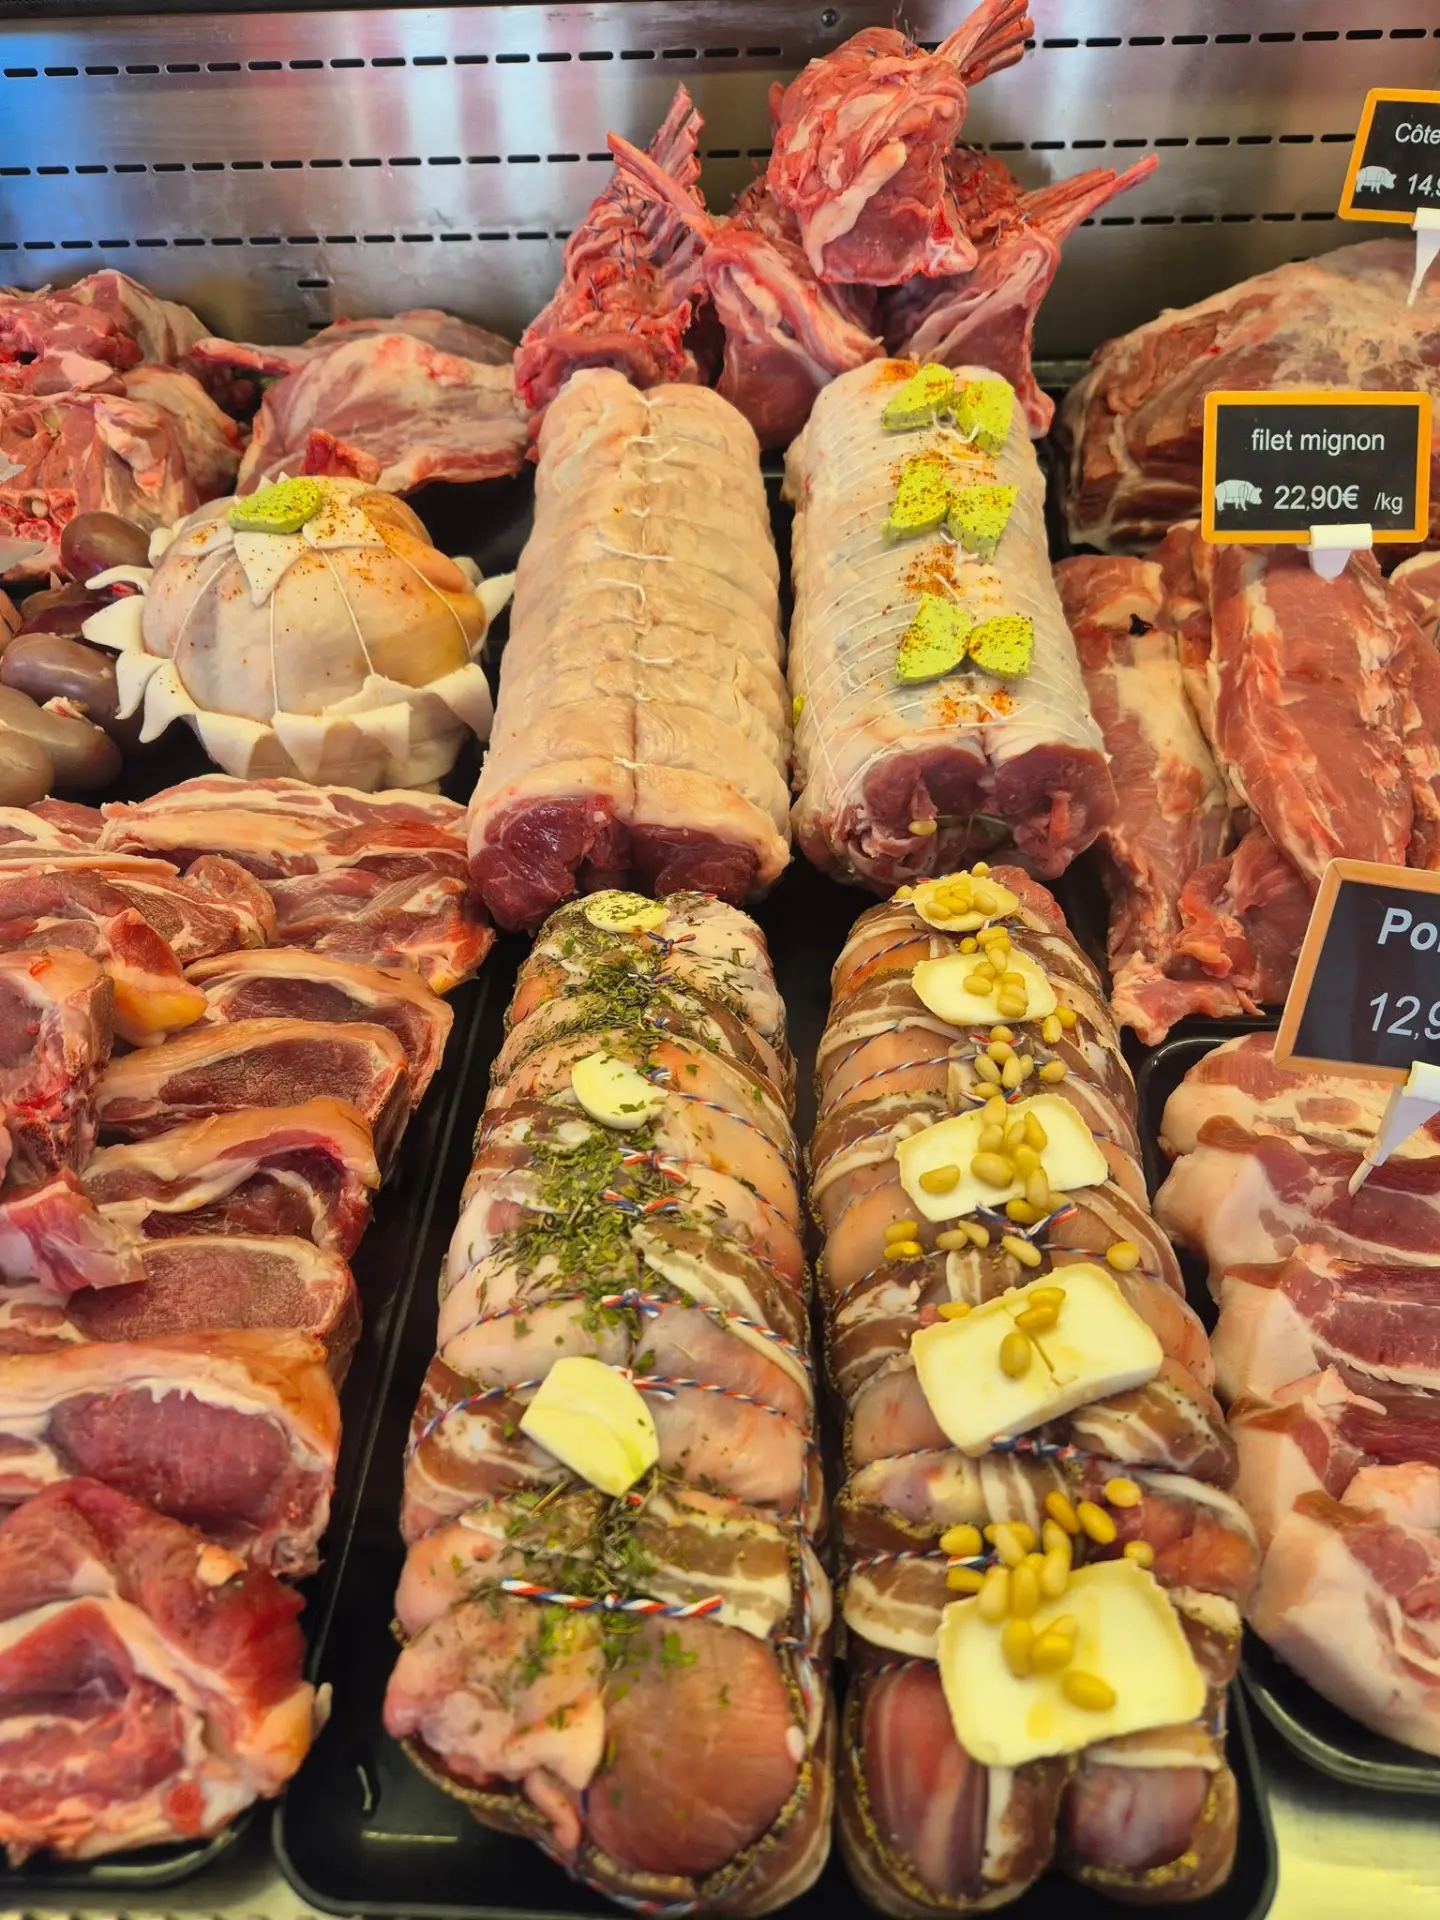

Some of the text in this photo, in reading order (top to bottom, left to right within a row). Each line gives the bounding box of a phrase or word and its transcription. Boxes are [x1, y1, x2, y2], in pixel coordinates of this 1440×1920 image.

[1395, 122, 1440, 145] Côte
[1251, 428, 1385, 457] filet mignon
[1273, 484, 1403, 515] 22,90€ /kg
[1377, 907, 1440, 953] Po
